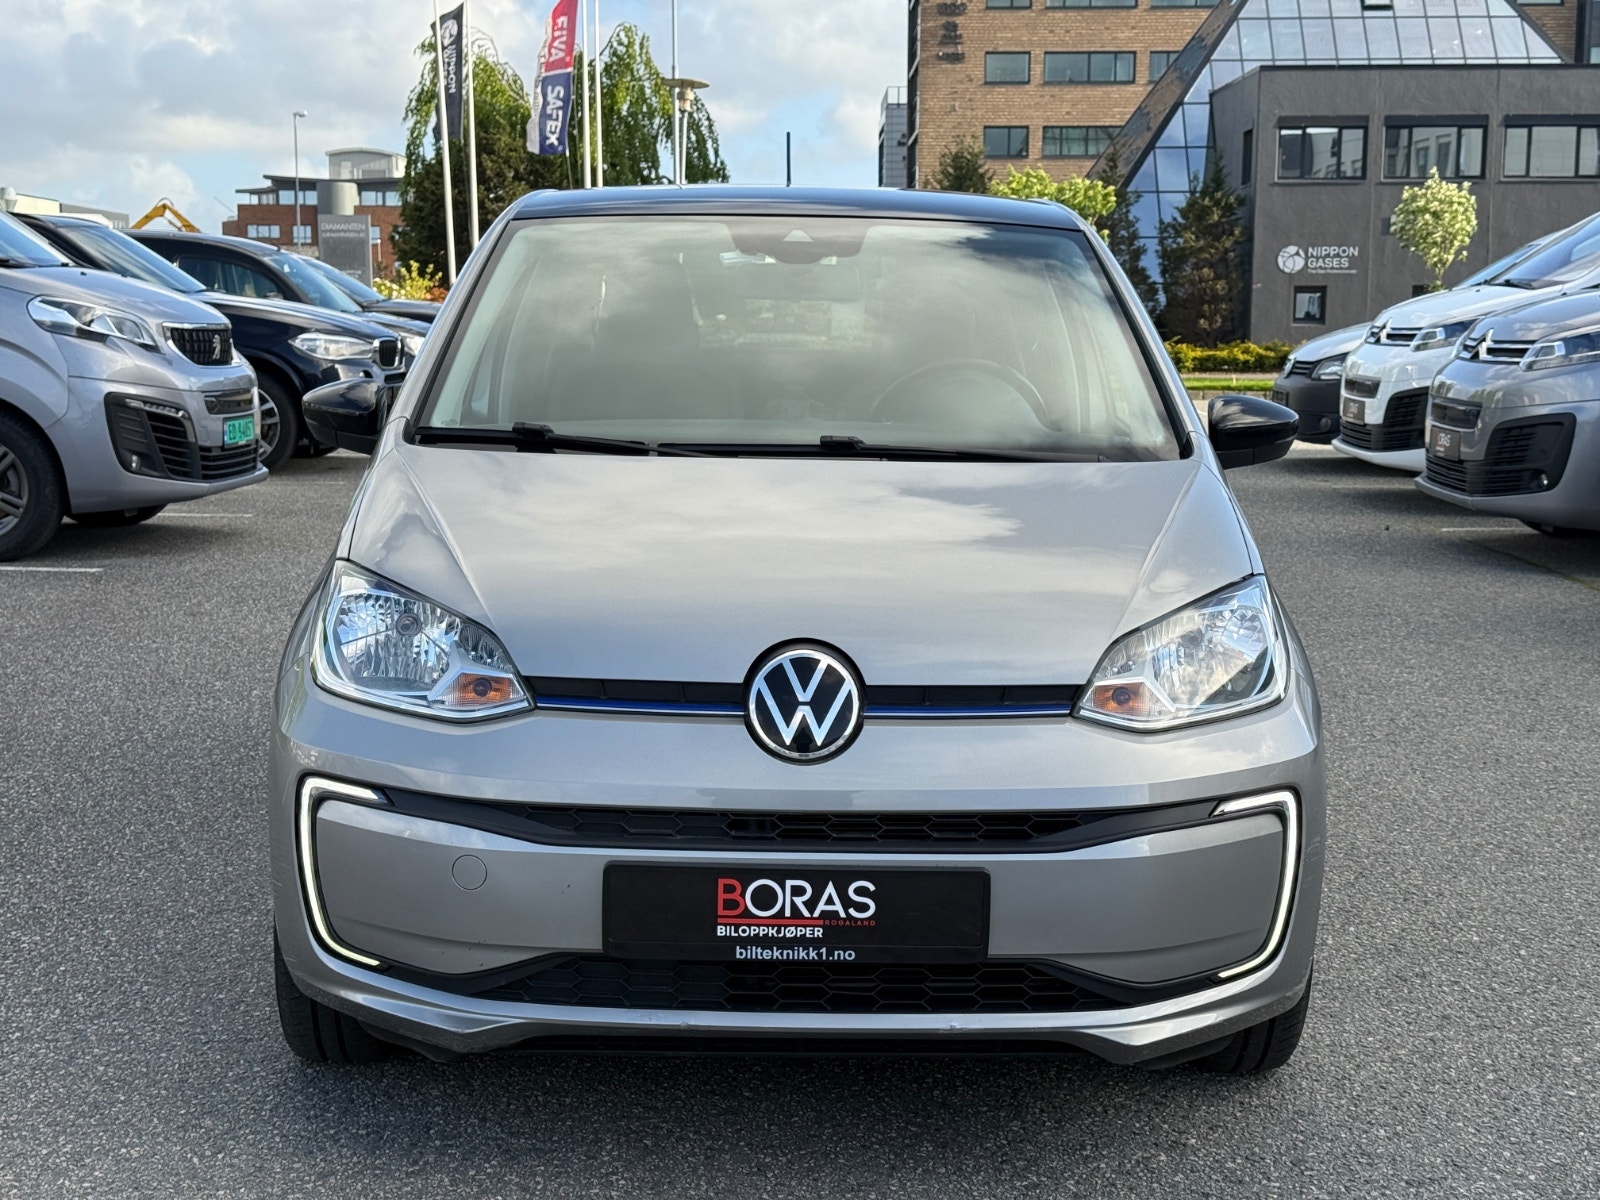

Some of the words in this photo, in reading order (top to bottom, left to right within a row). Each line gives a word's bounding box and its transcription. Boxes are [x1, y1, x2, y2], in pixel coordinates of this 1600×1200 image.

[545, 85, 564, 147] SAFEX
[1307, 246, 1359, 257] NIPPON
[1307, 258, 1349, 268] GASES
[717, 878, 876, 919] BORAS
[717, 926, 823, 938] BILOPPKJØPER
[736, 946, 856, 960] bilteknikk1.no
